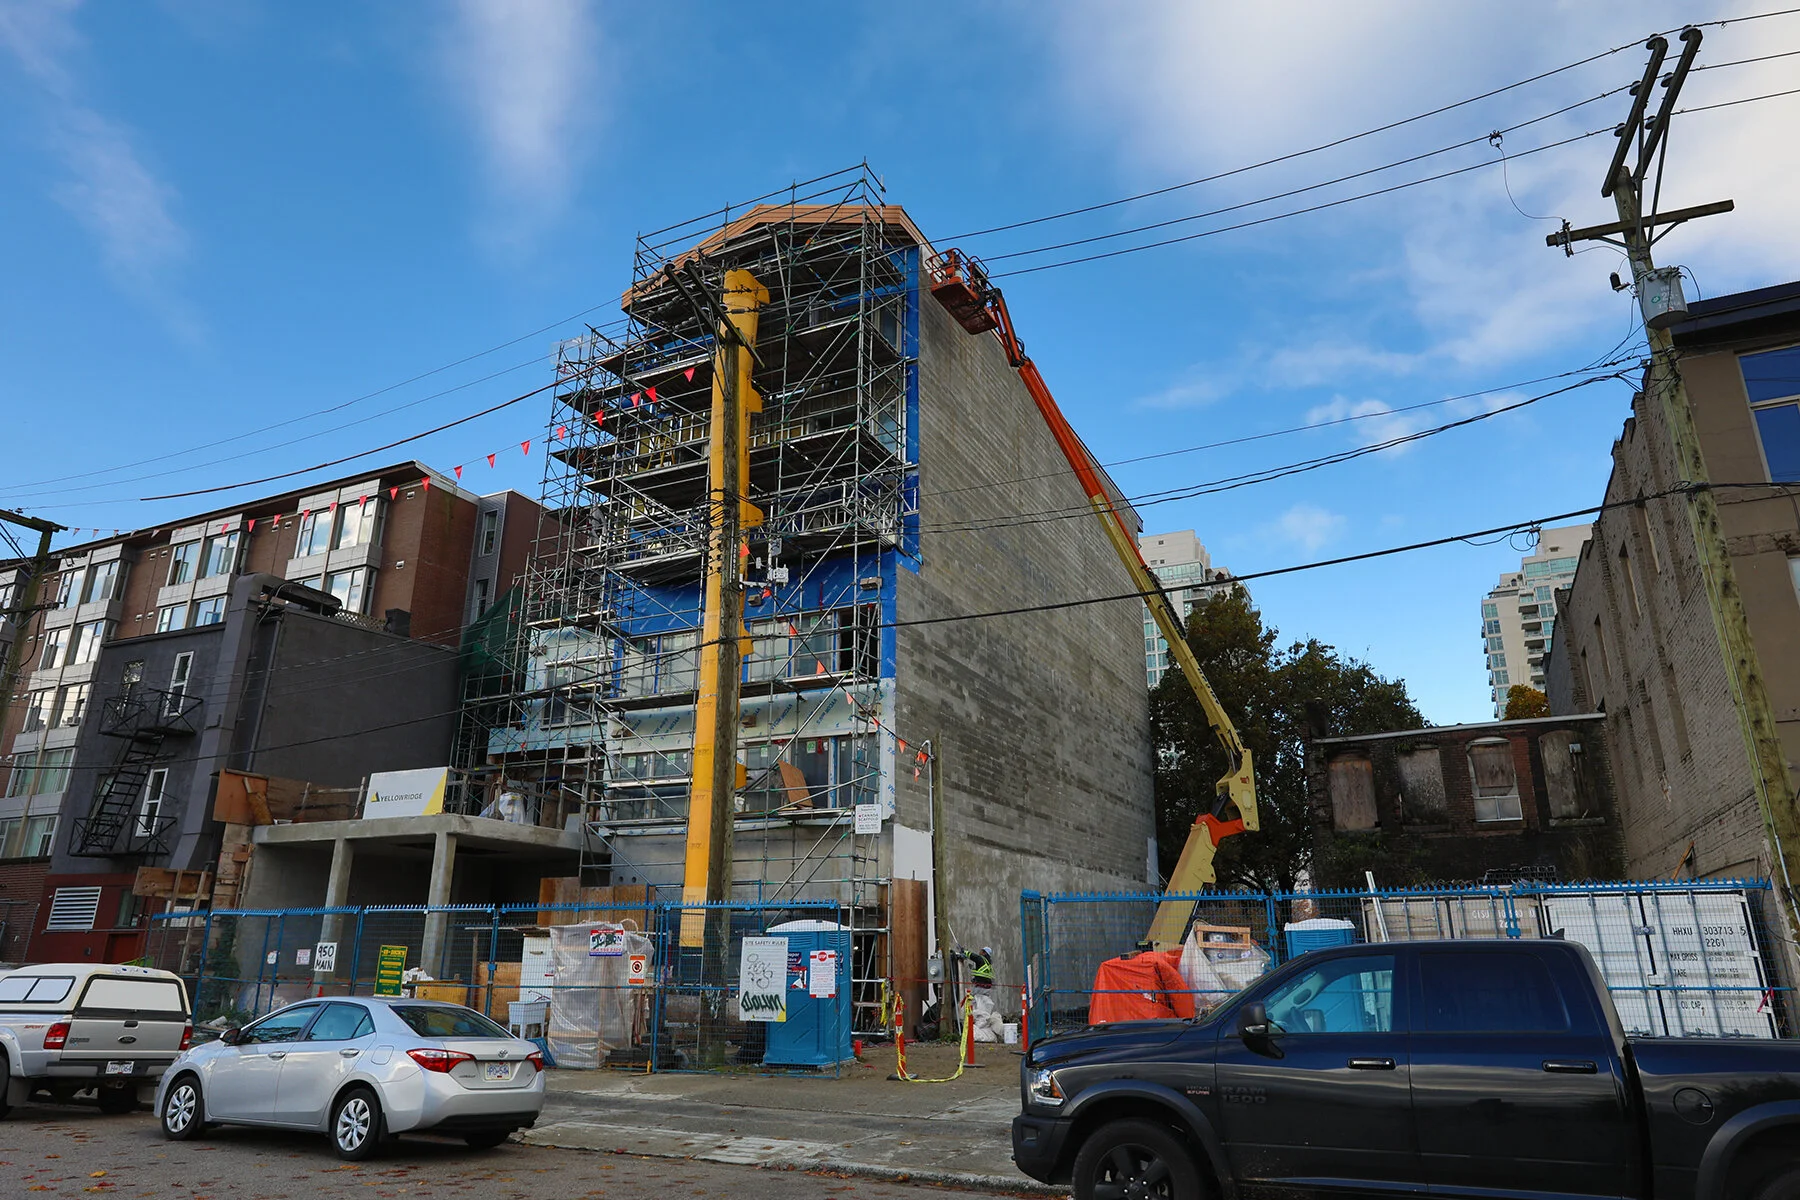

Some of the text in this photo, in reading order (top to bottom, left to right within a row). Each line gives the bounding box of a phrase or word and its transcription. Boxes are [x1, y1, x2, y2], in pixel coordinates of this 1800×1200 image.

[380, 792, 423, 802] YELLOWRIDGE
[1672, 926, 1747, 936] HHXU 303713 5
[1705, 938, 1725, 947] 22G1
[318, 945, 335, 958] 950
[314, 960, 333, 970] MAIN
[1673, 969, 1687, 978] TARE
[1221, 1086, 1266, 1095] RAM
[1221, 1095, 1267, 1104] 1500
